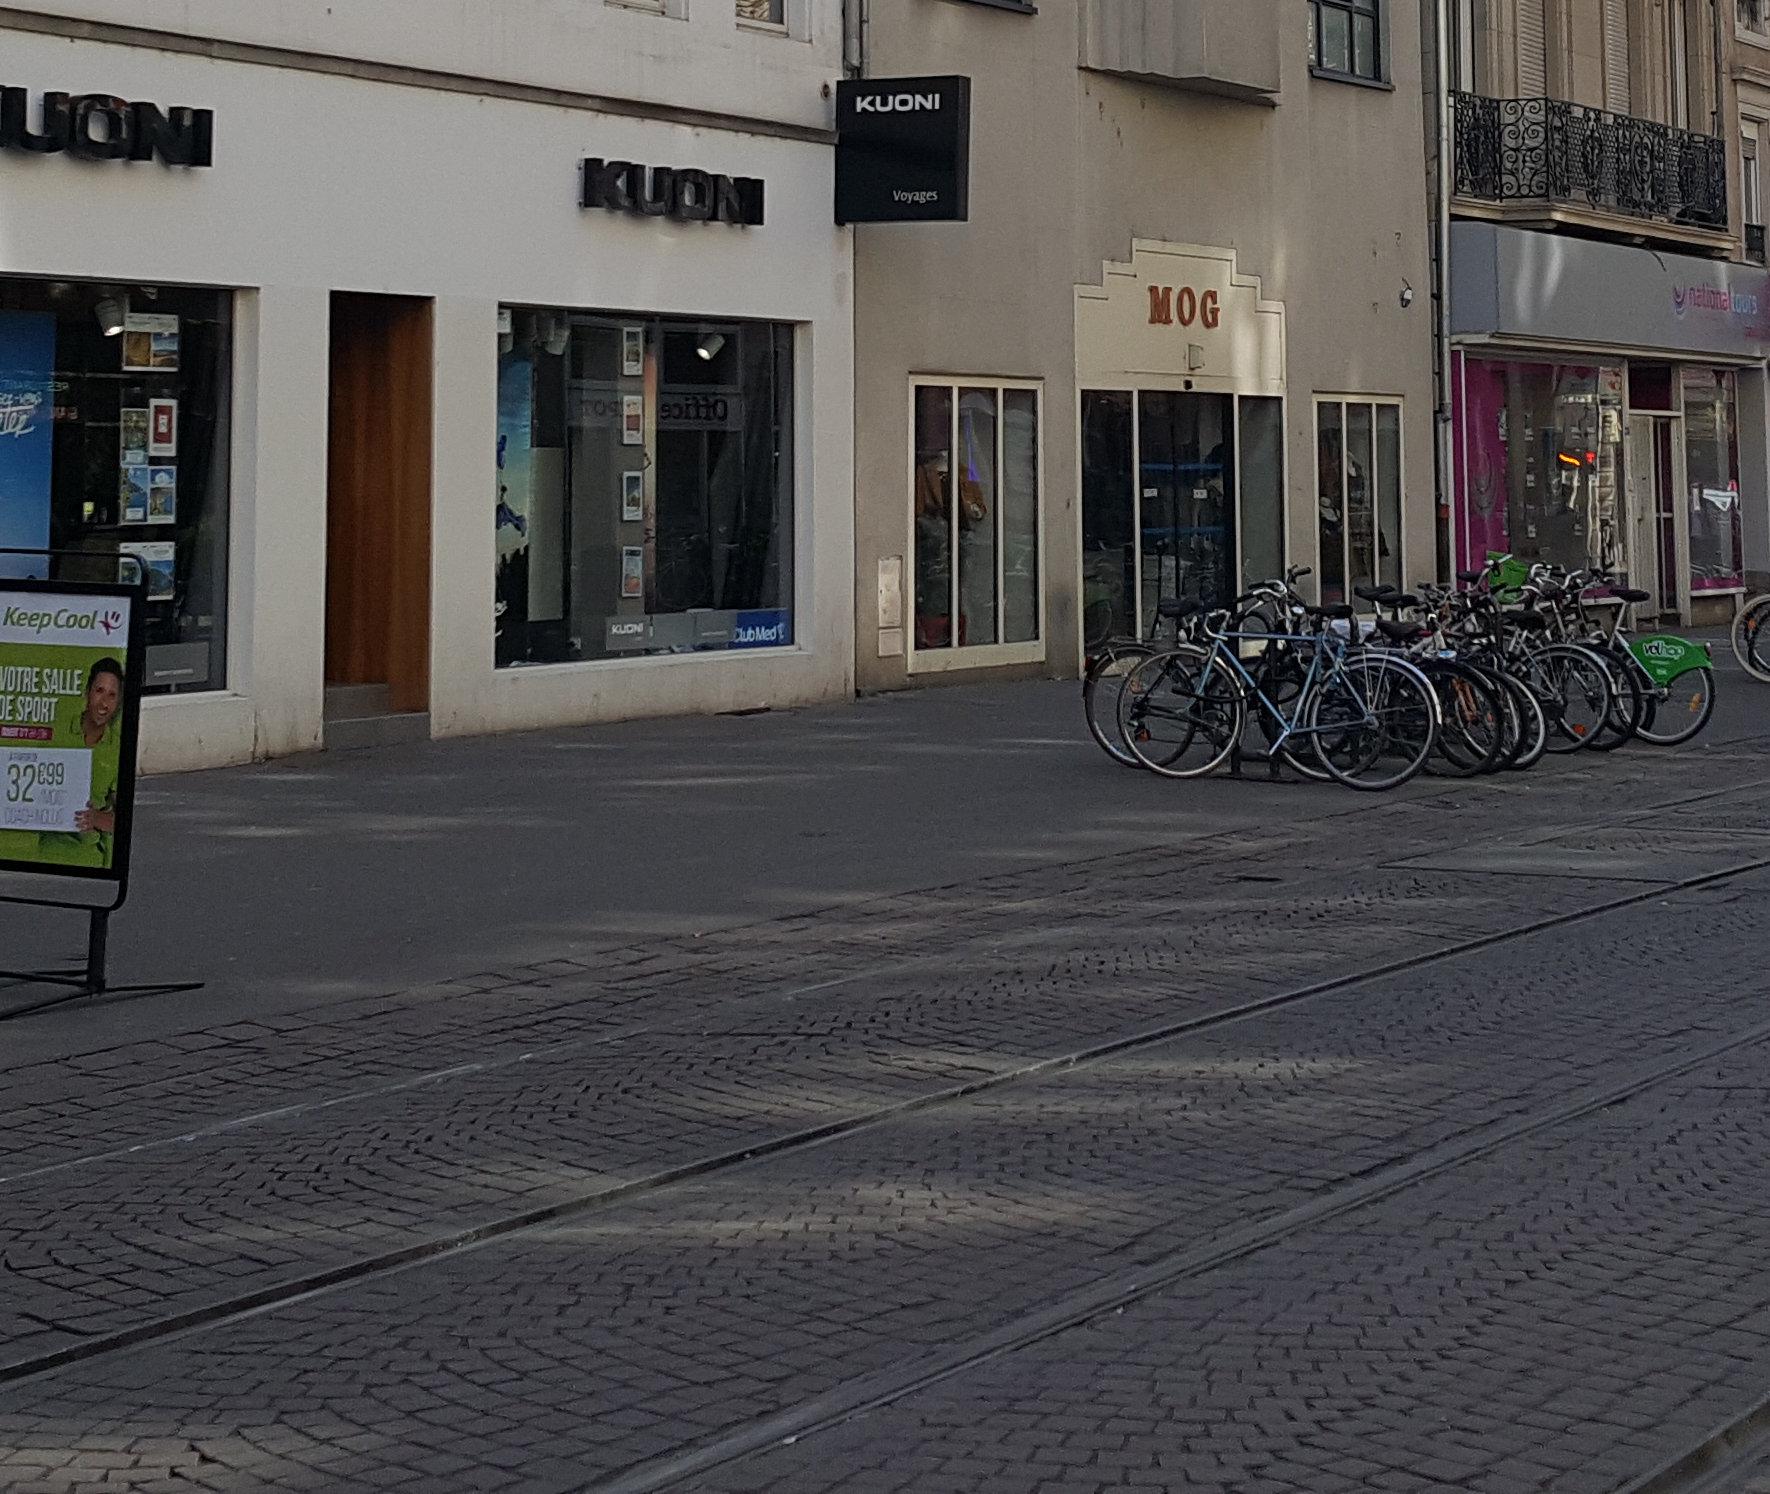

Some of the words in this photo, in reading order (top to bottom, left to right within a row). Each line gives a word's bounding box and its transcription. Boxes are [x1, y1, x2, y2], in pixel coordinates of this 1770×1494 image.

[855, 92, 941, 113] KUONI
[582, 157, 765, 227] KUONI
[892, 189, 938, 204] Voyages
[1147, 285, 1221, 329] MOG
[0, 666, 40, 694] VOTRE
[41, 668, 84, 696] SALLE
[16, 696, 59, 723] SPORT
